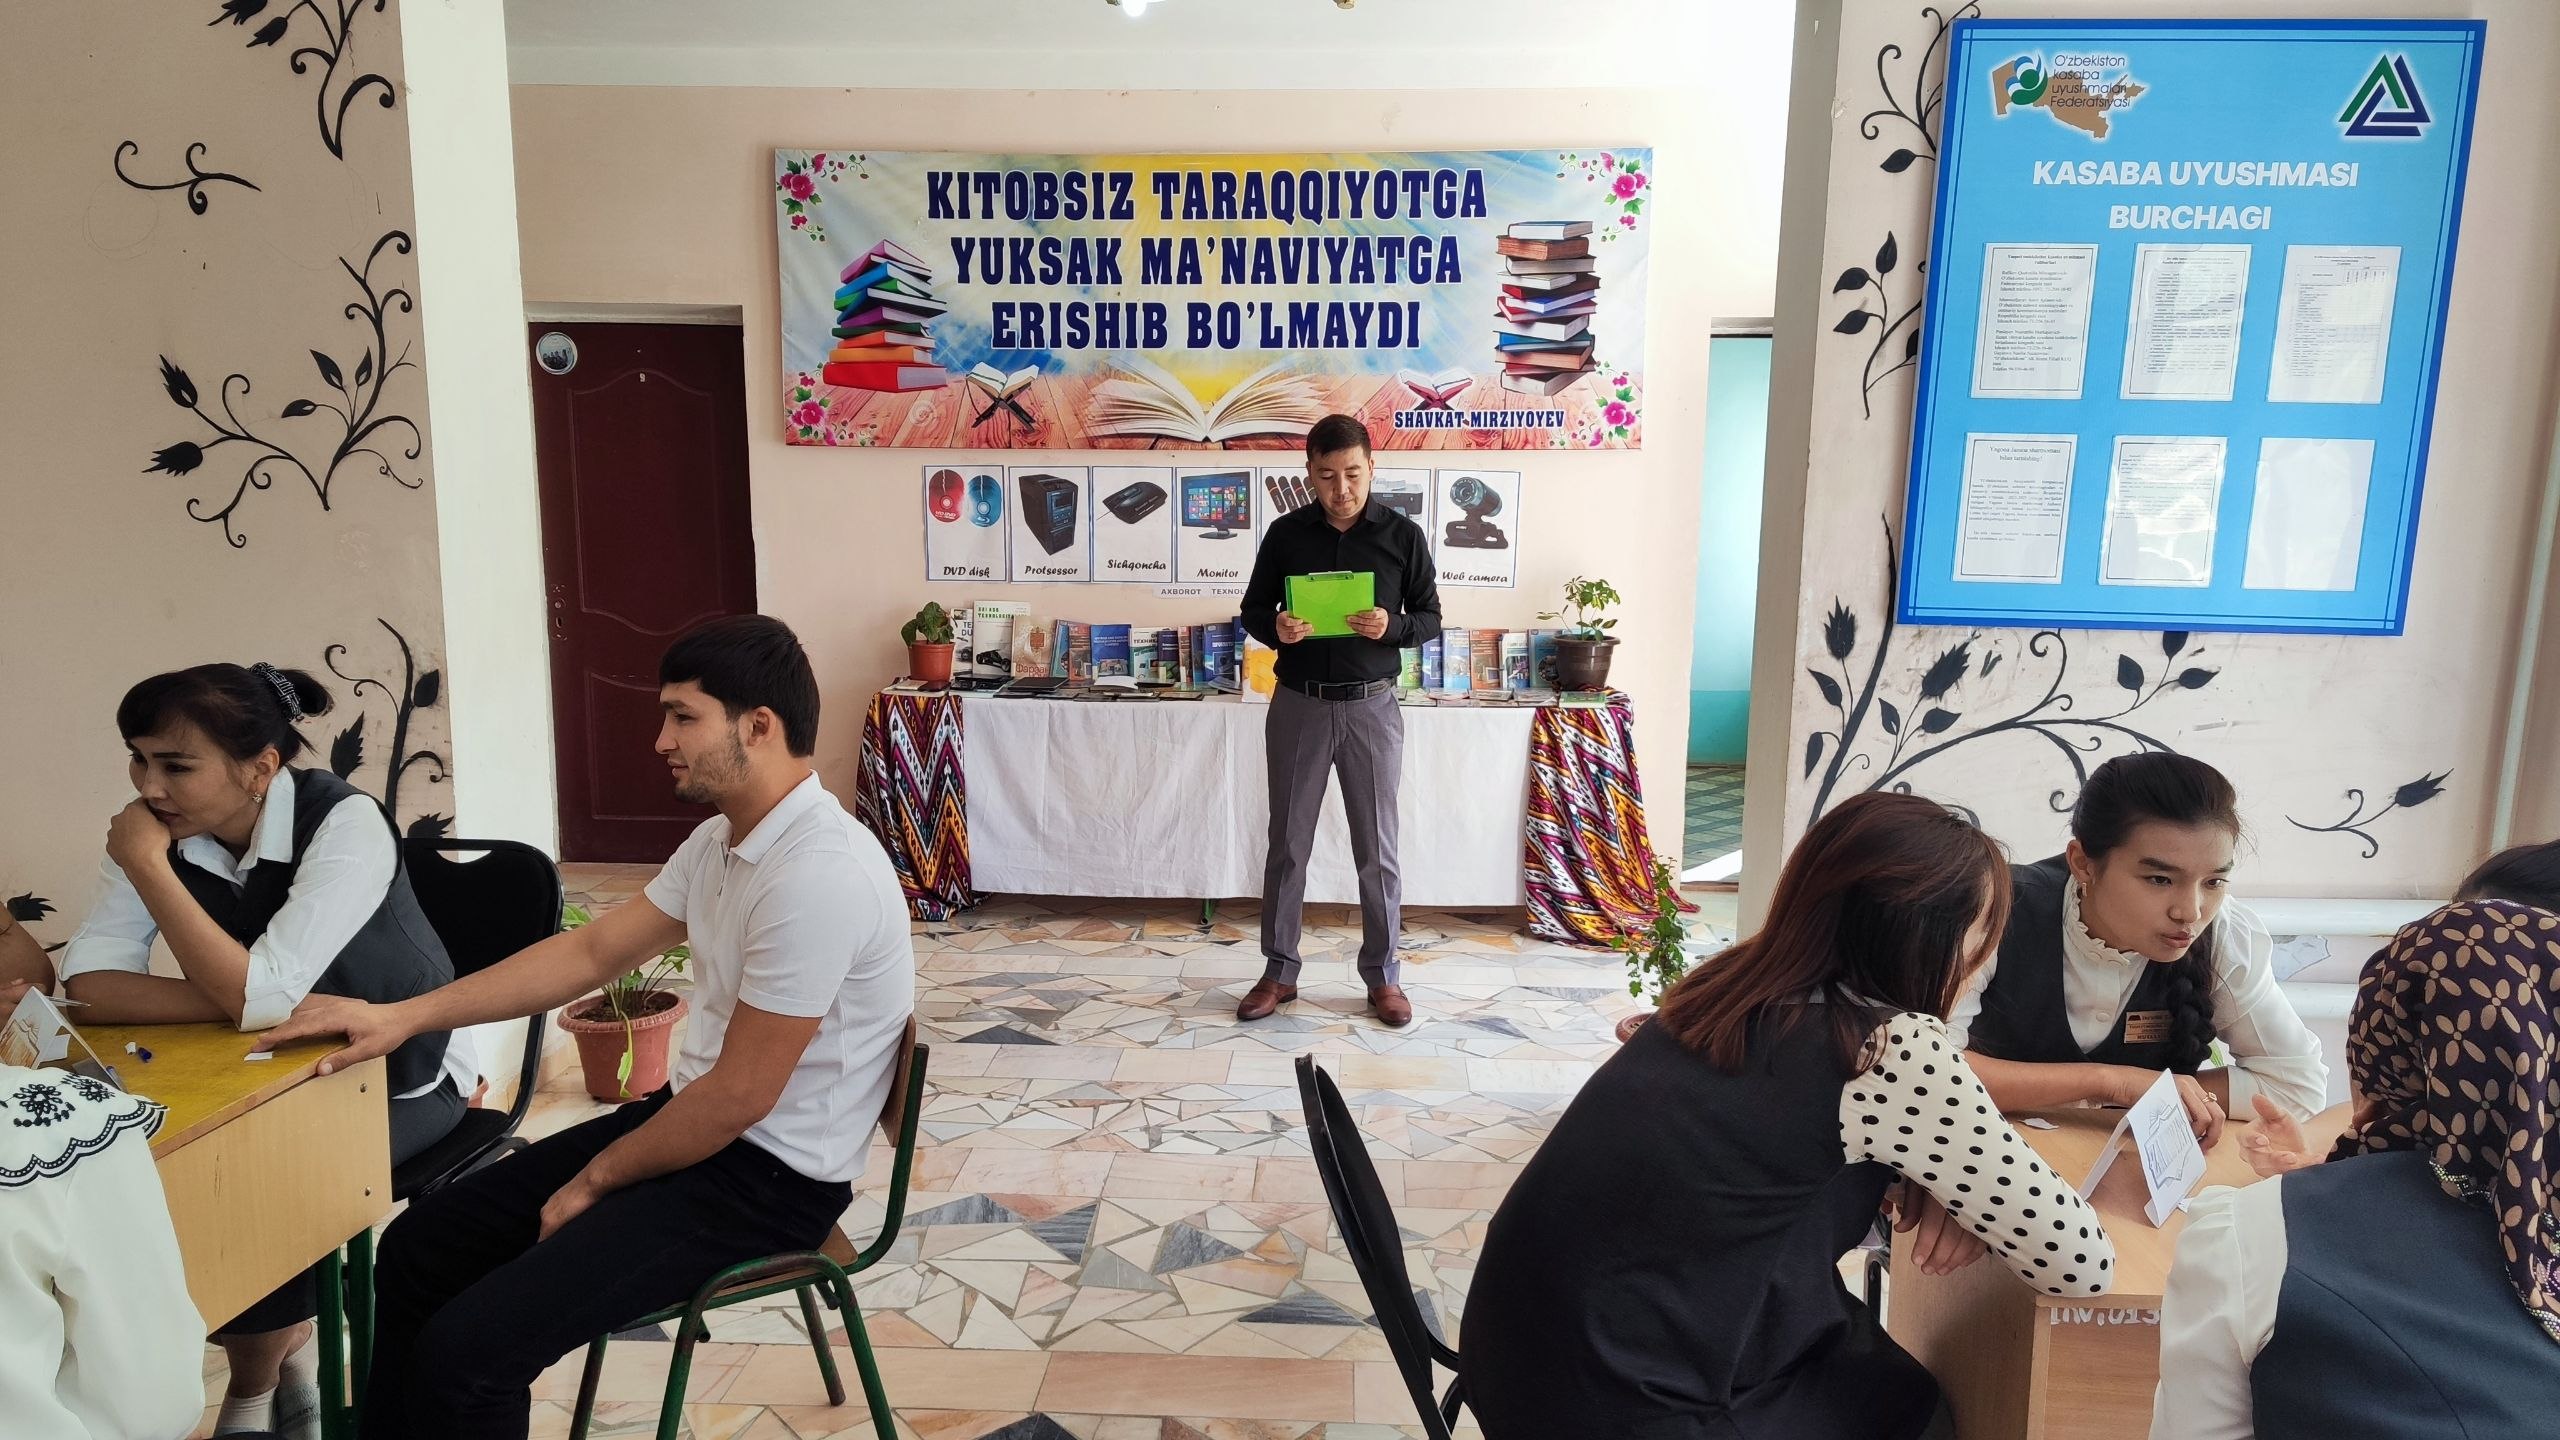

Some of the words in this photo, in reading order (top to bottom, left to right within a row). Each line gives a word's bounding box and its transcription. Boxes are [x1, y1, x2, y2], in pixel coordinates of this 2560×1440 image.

[2054, 54, 2126, 67] O'zbekiston
[2053, 69, 2100, 80] kasaba
[2051, 82, 2127, 96] uyushmalari
[2049, 96, 2131, 109] Federatsiyasi
[2032, 160, 2163, 186] KASABA
[2169, 161, 2360, 188] UYUSHMASI
[928, 171, 1134, 221] KITOBSIZ
[1154, 169, 1488, 226] TARAQQIYOTGA
[2108, 204, 2272, 231] BURCHAGI
[952, 236, 1123, 286] YUKSAK
[1140, 235, 1463, 286] MA’NAVIYATGA
[991, 301, 1169, 351] ERISHIB
[1186, 301, 1421, 351] BO’LMAYDI
[1394, 411, 1465, 428] SHAVKAT
[1470, 411, 1565, 428] MIRZIYOYEV
[943, 566, 966, 576] DVD
[969, 567, 990, 578] disk
[1024, 565, 1078, 577] Protsessor
[1107, 559, 1167, 572] Sichqoncha
[1197, 568, 1239, 579] Monitor
[1442, 571, 1465, 581] Web
[1468, 573, 1508, 583] camera
